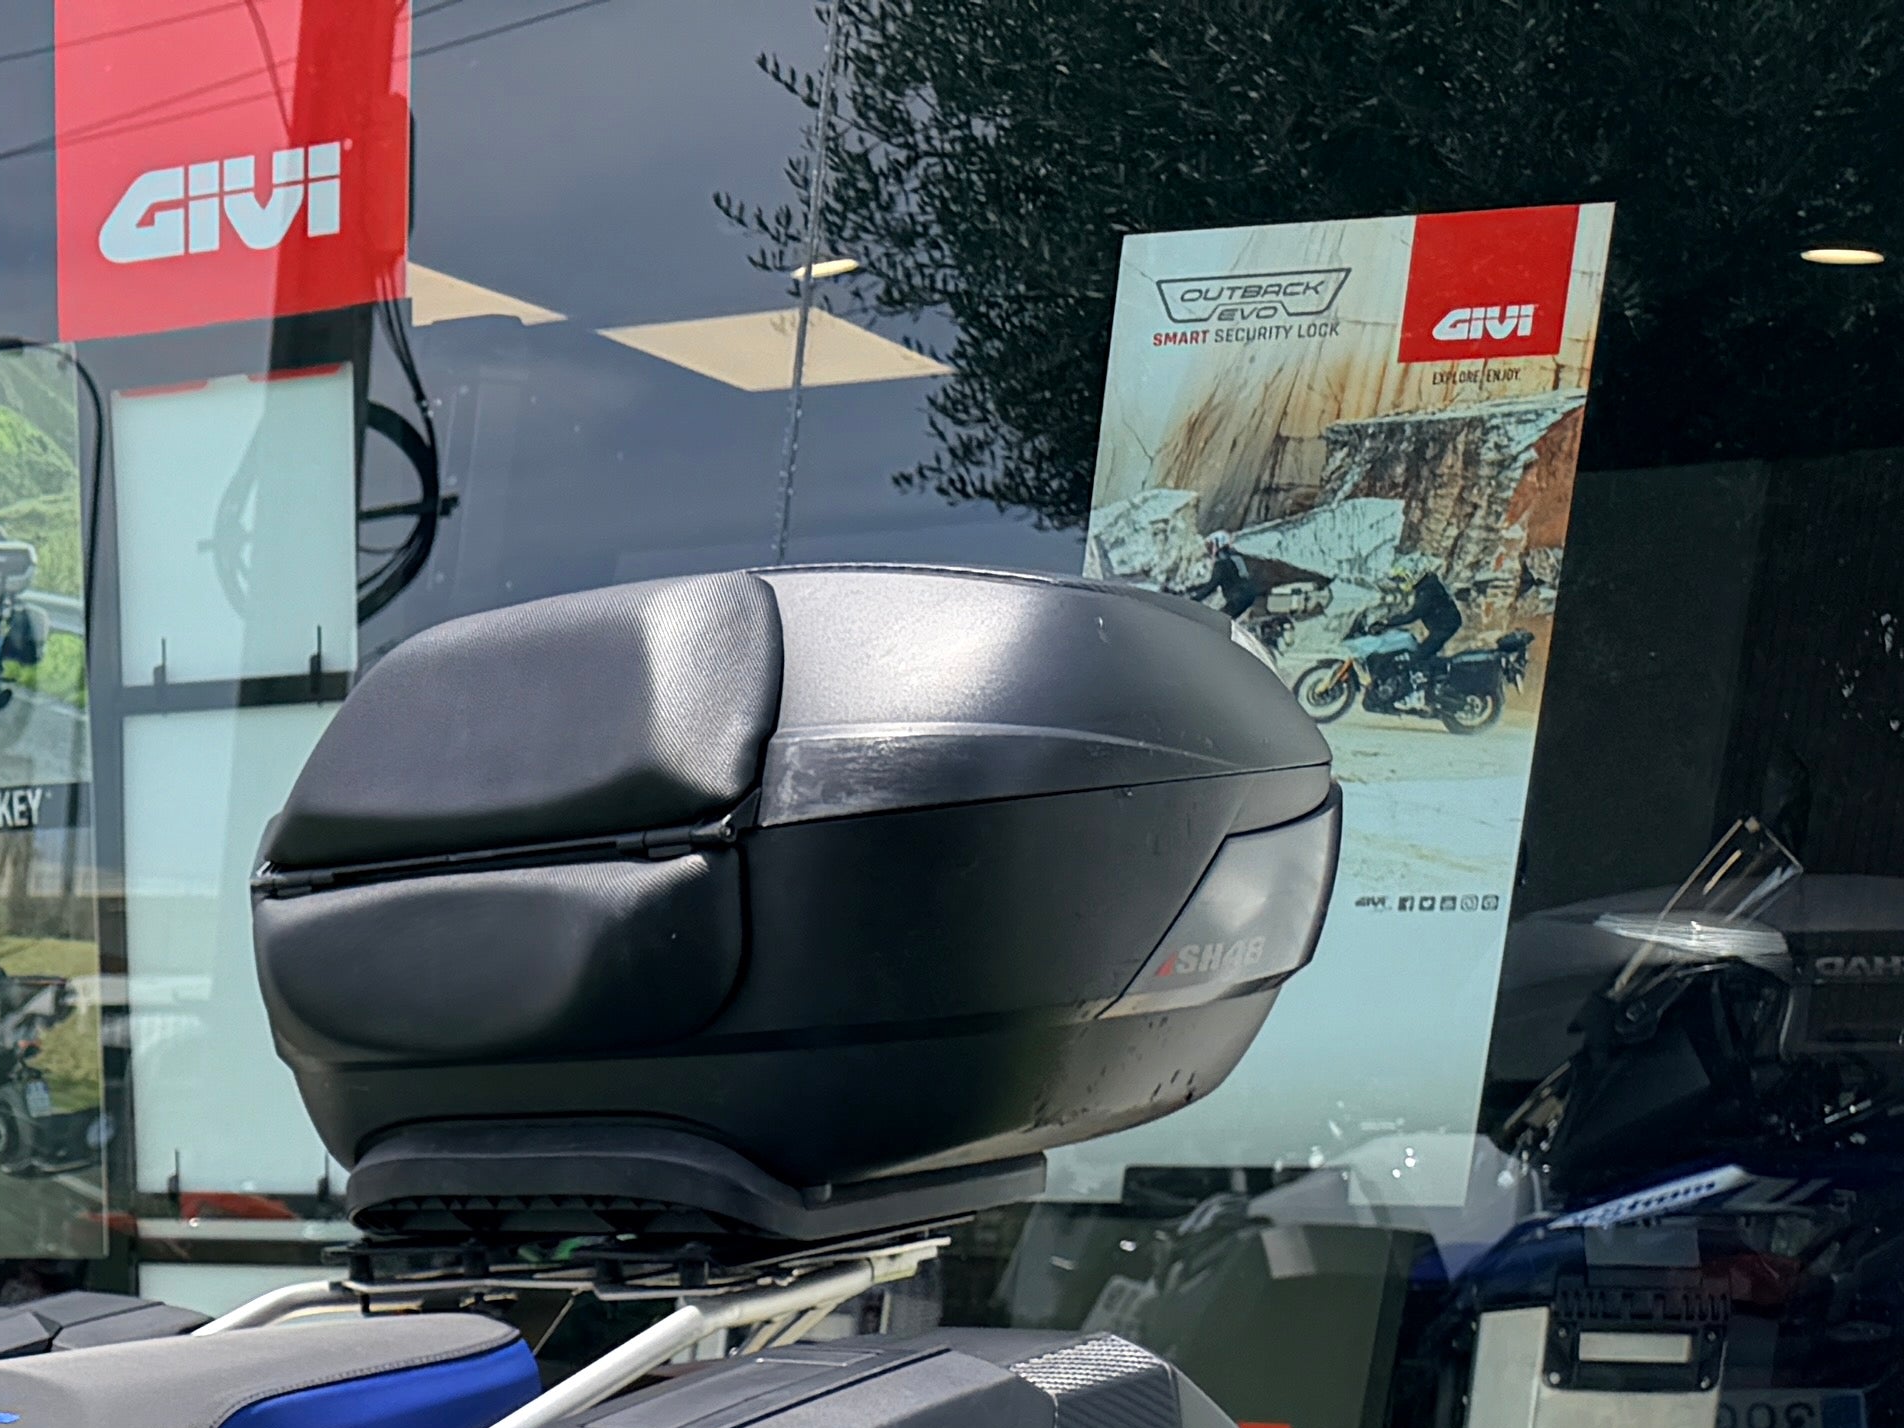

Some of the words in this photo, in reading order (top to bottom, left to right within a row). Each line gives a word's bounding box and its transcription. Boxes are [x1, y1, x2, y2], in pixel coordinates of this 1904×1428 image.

[99, 141, 341, 263] GIVI
[1180, 280, 1325, 302] OUTBACK
[1217, 306, 1278, 322] EVO
[1432, 304, 1535, 341] GIVI
[1153, 330, 1209, 347] SMART
[1214, 325, 1293, 343] SECURITY
[1297, 322, 1340, 339] LOCK
[1175, 936, 1267, 974] SH48
